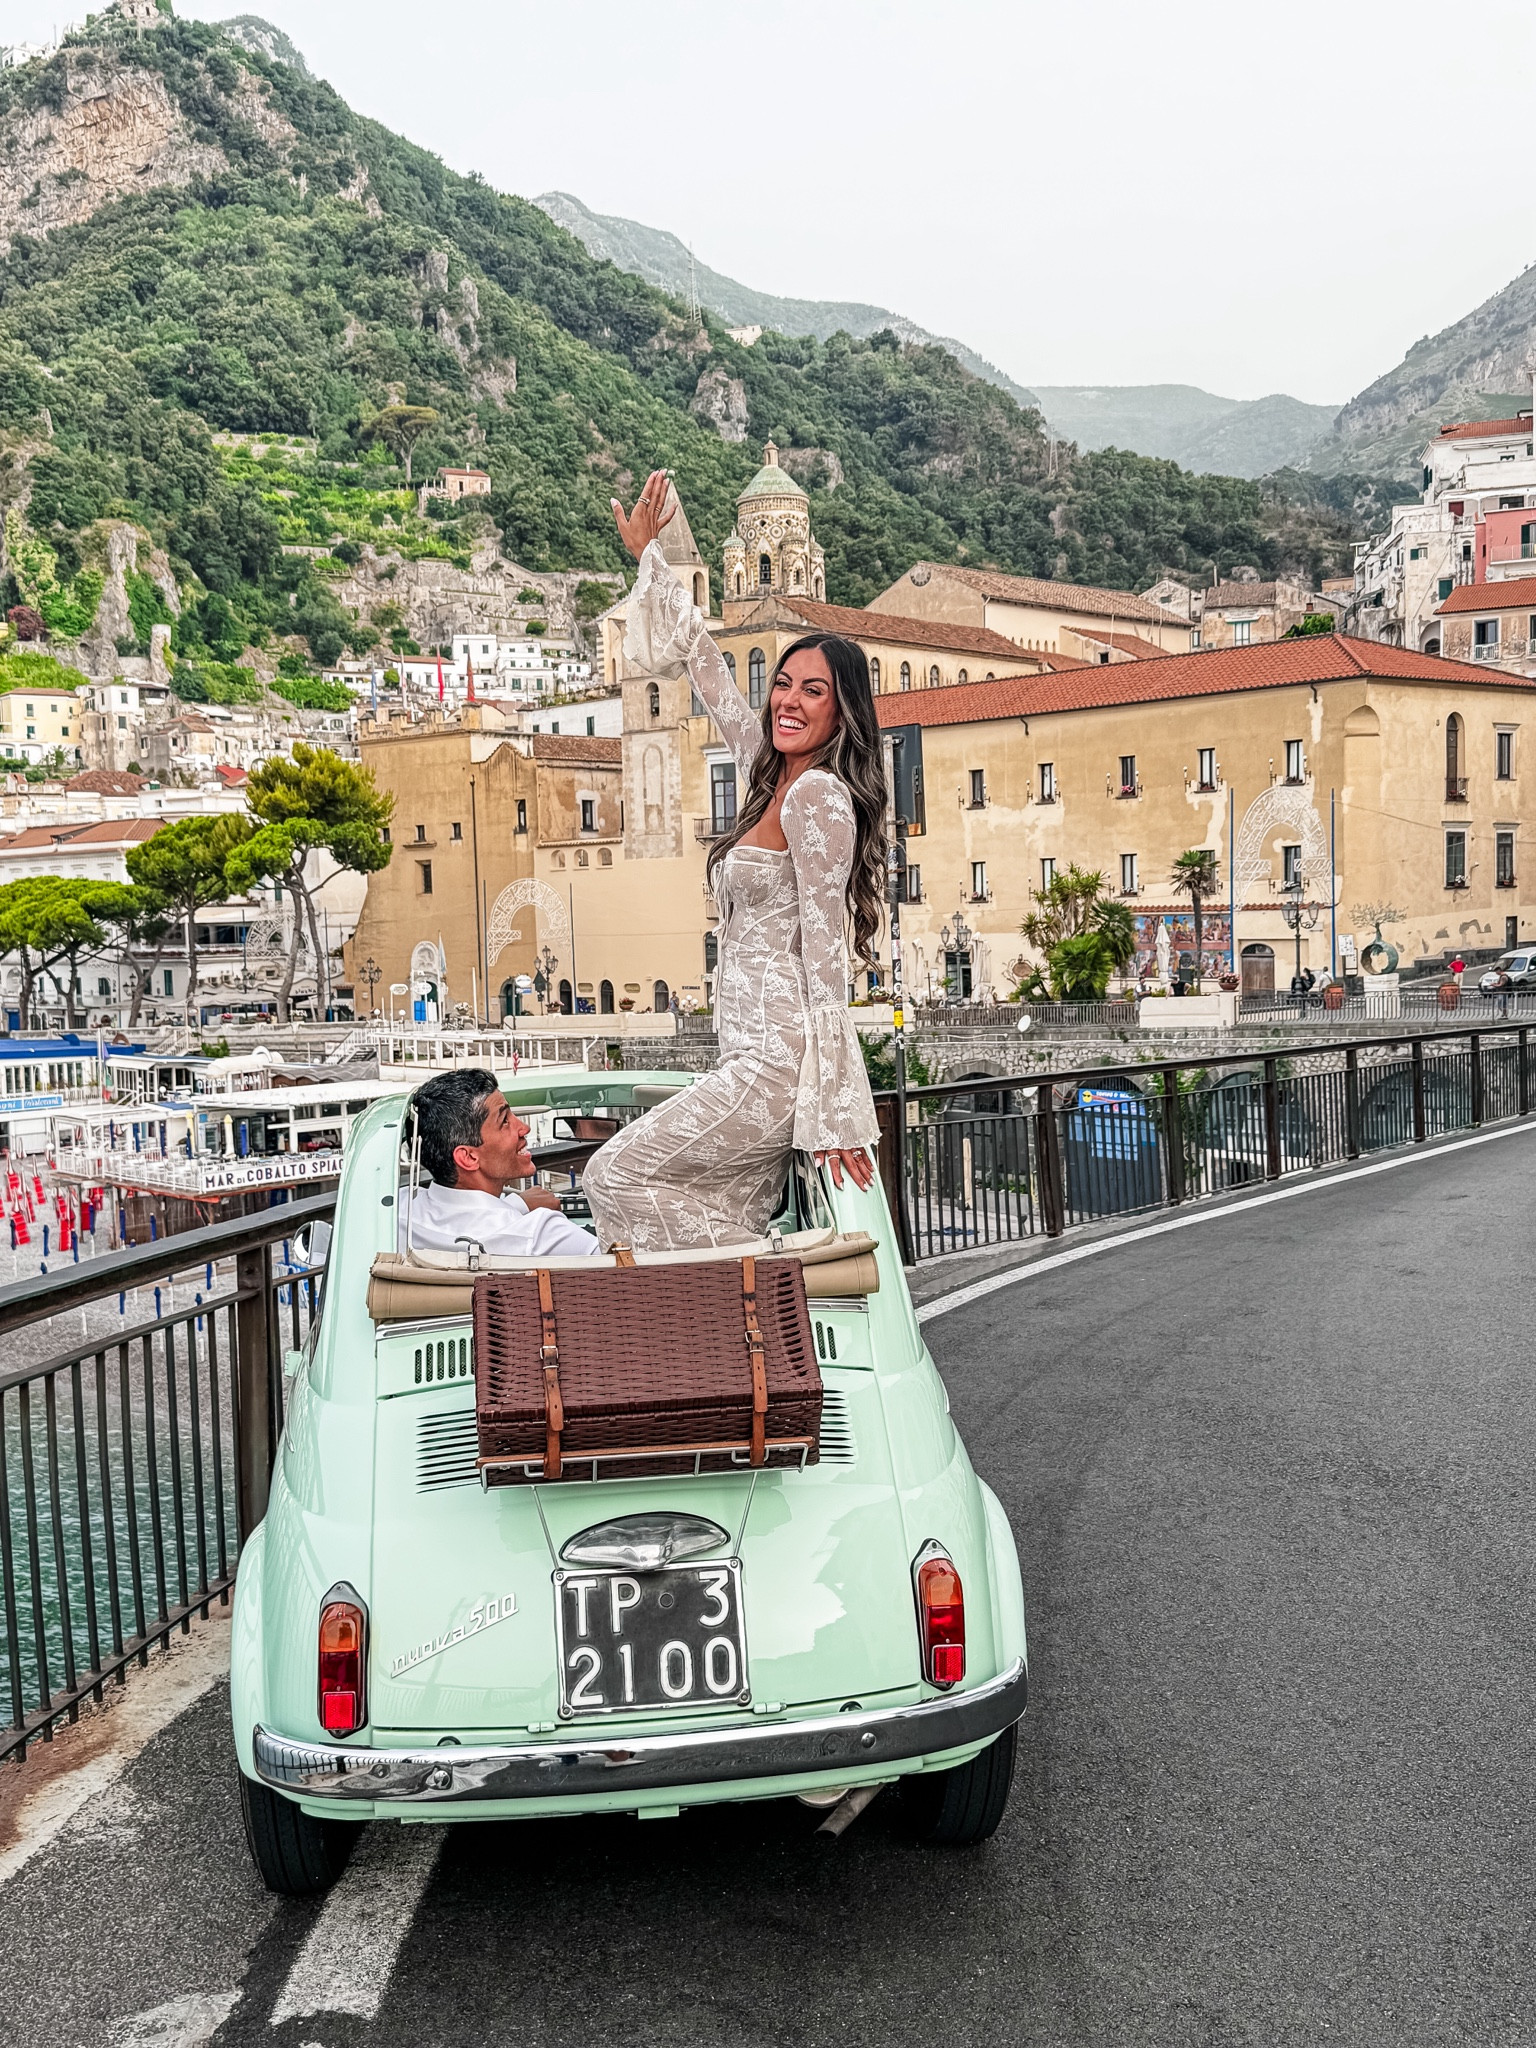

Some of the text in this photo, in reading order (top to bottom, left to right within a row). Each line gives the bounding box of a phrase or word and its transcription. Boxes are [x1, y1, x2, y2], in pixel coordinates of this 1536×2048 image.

[205, 1173, 234, 1188] MAR
[247, 1163, 306, 1182] COBALTO
[391, 1592, 518, 1677] nuova 500
[566, 1570, 730, 1637] TP 3
[568, 1636, 737, 1706] 2100
